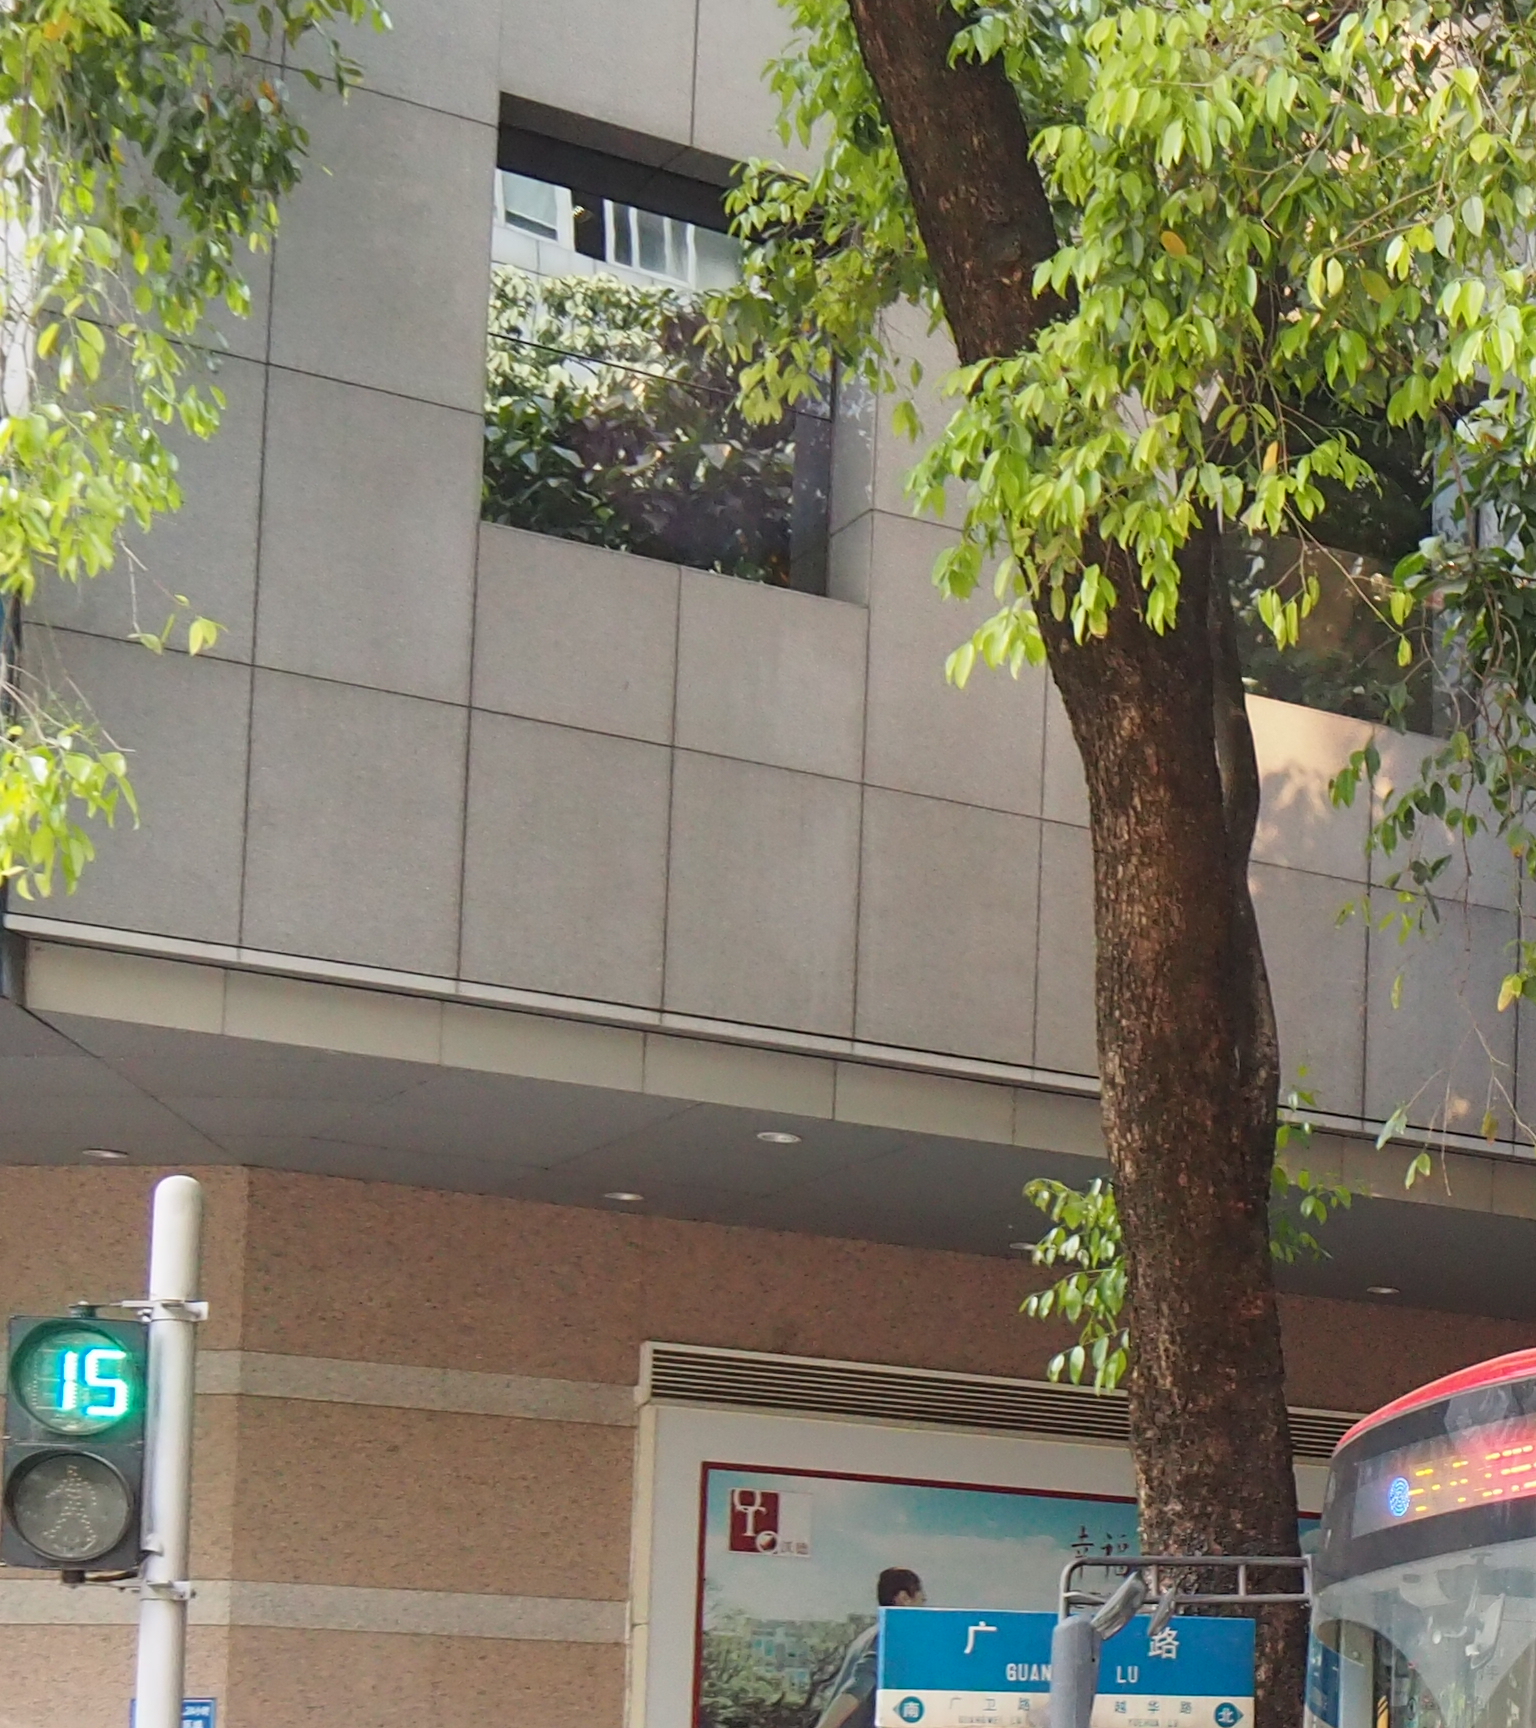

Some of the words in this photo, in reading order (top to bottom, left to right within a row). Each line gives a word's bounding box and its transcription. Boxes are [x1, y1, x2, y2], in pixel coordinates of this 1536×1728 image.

[62, 1348, 129, 1416] 15
[1115, 1665, 1139, 1684] LU
[1217, 1707, 1235, 1724] 北
